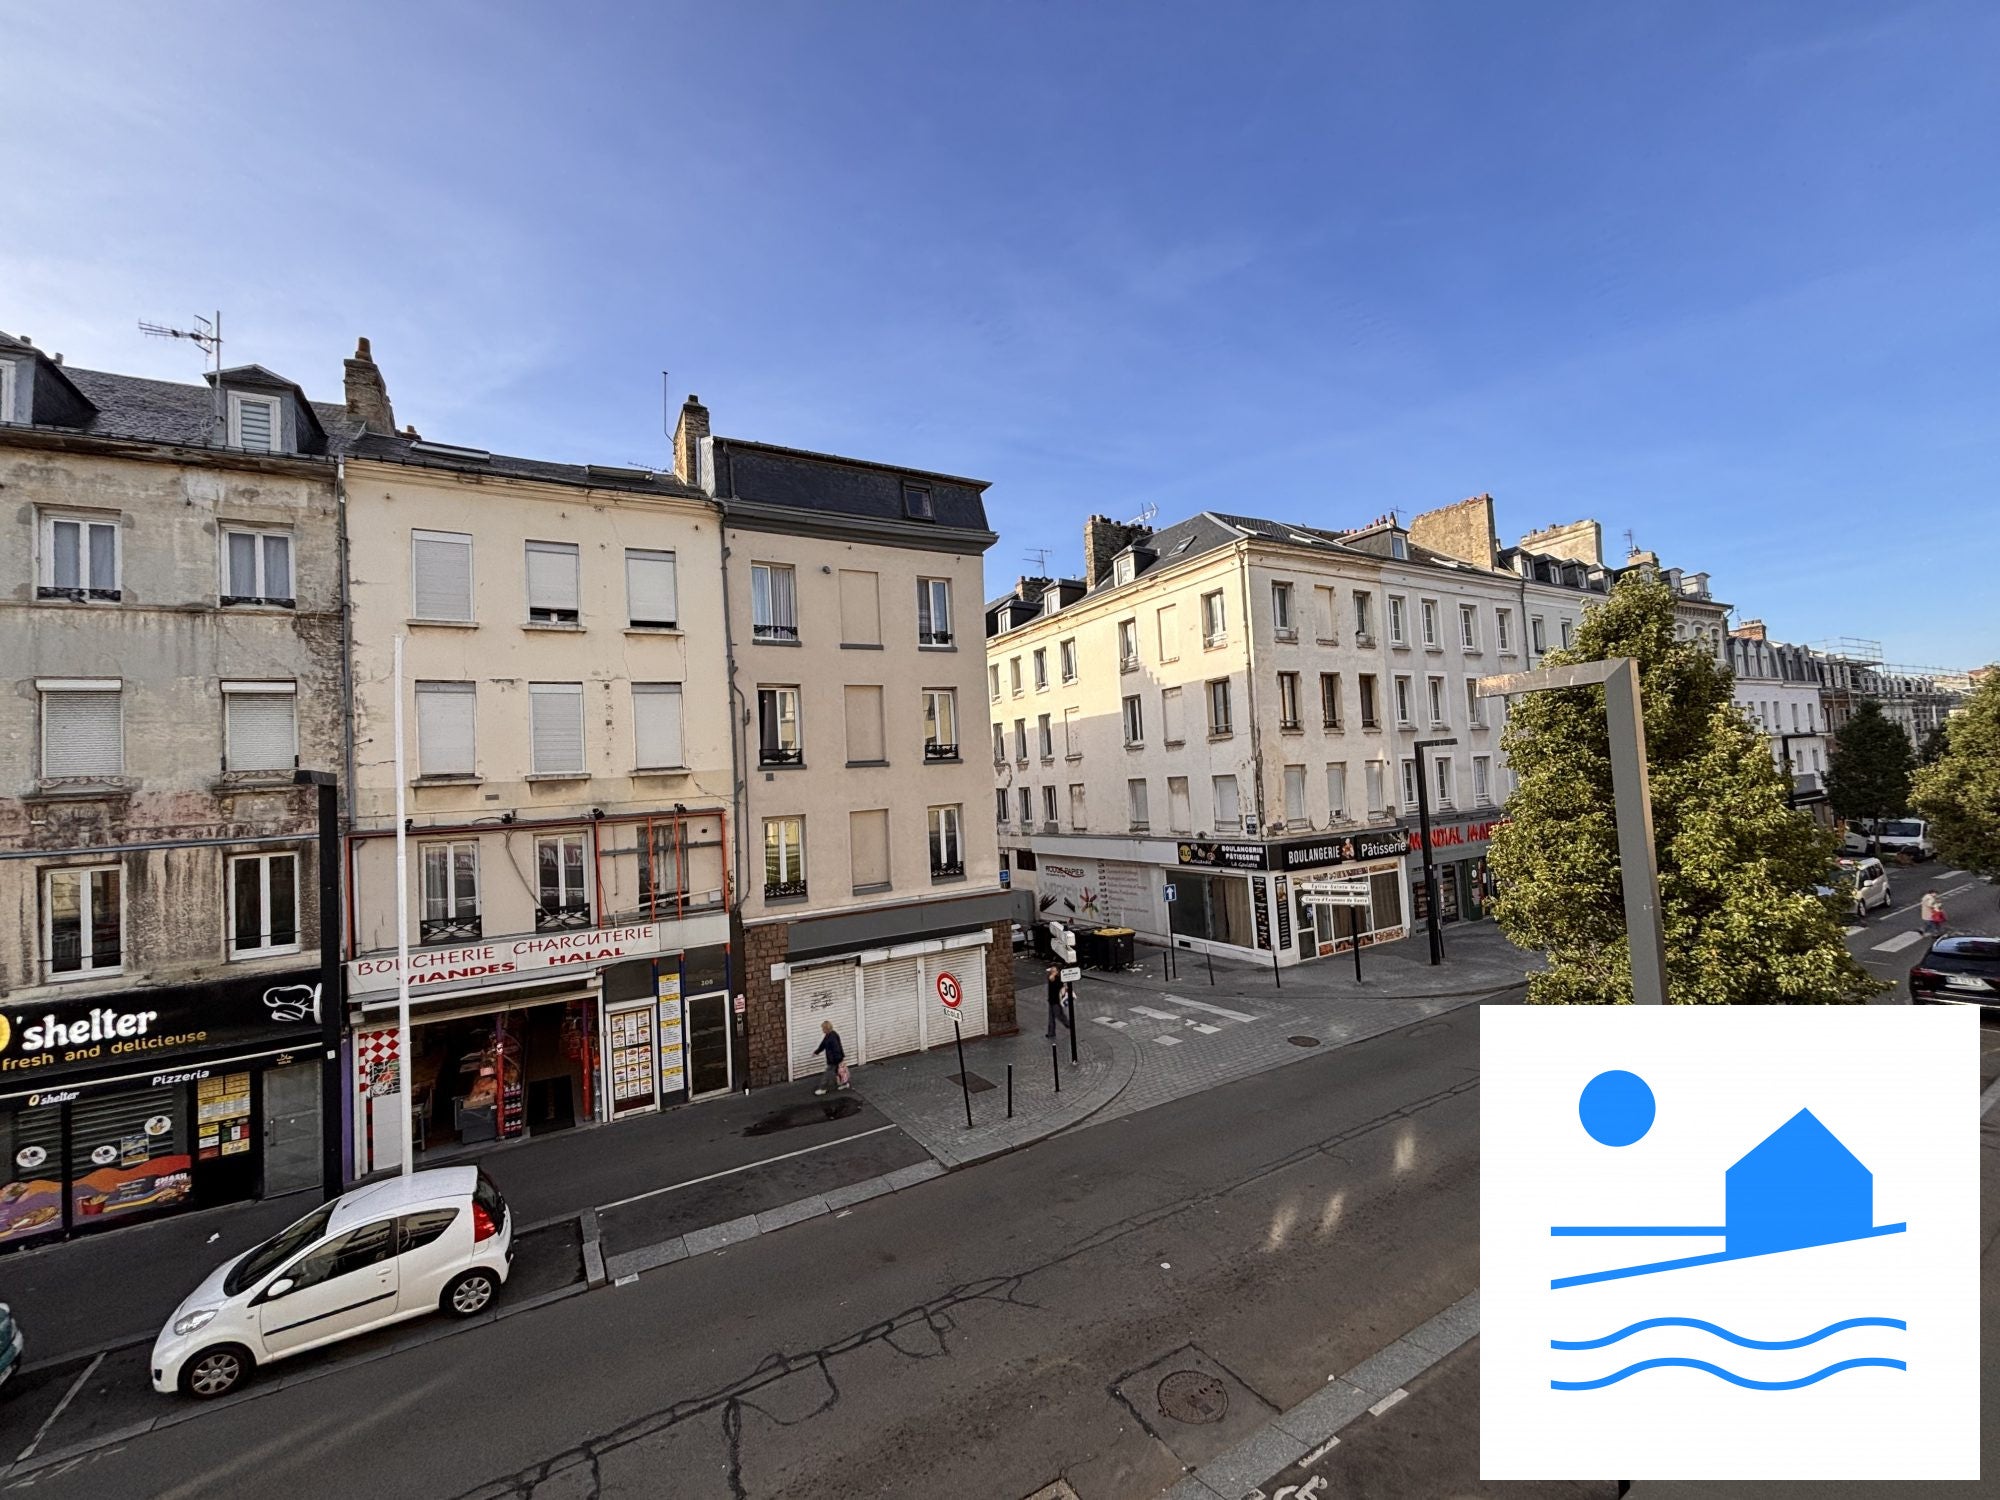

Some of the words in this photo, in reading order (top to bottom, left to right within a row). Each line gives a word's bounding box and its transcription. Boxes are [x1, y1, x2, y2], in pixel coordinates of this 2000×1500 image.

[1221, 845, 1263, 853] BOULANGERIE
[1409, 827, 1463, 851] MNDIAL
[1288, 845, 1340, 864] BOULANGERIE
[1361, 841, 1406, 857] Pâtisserie
[513, 926, 654, 955] CHARCUTERIE
[549, 947, 625, 965] HALAL
[941, 981, 956, 999] 30
[2, 1053, 55, 1071] fresh
[65, 1045, 101, 1061] and
[111, 1031, 208, 1054] delicieuse
[152, 1070, 209, 1086] Pizzeria
